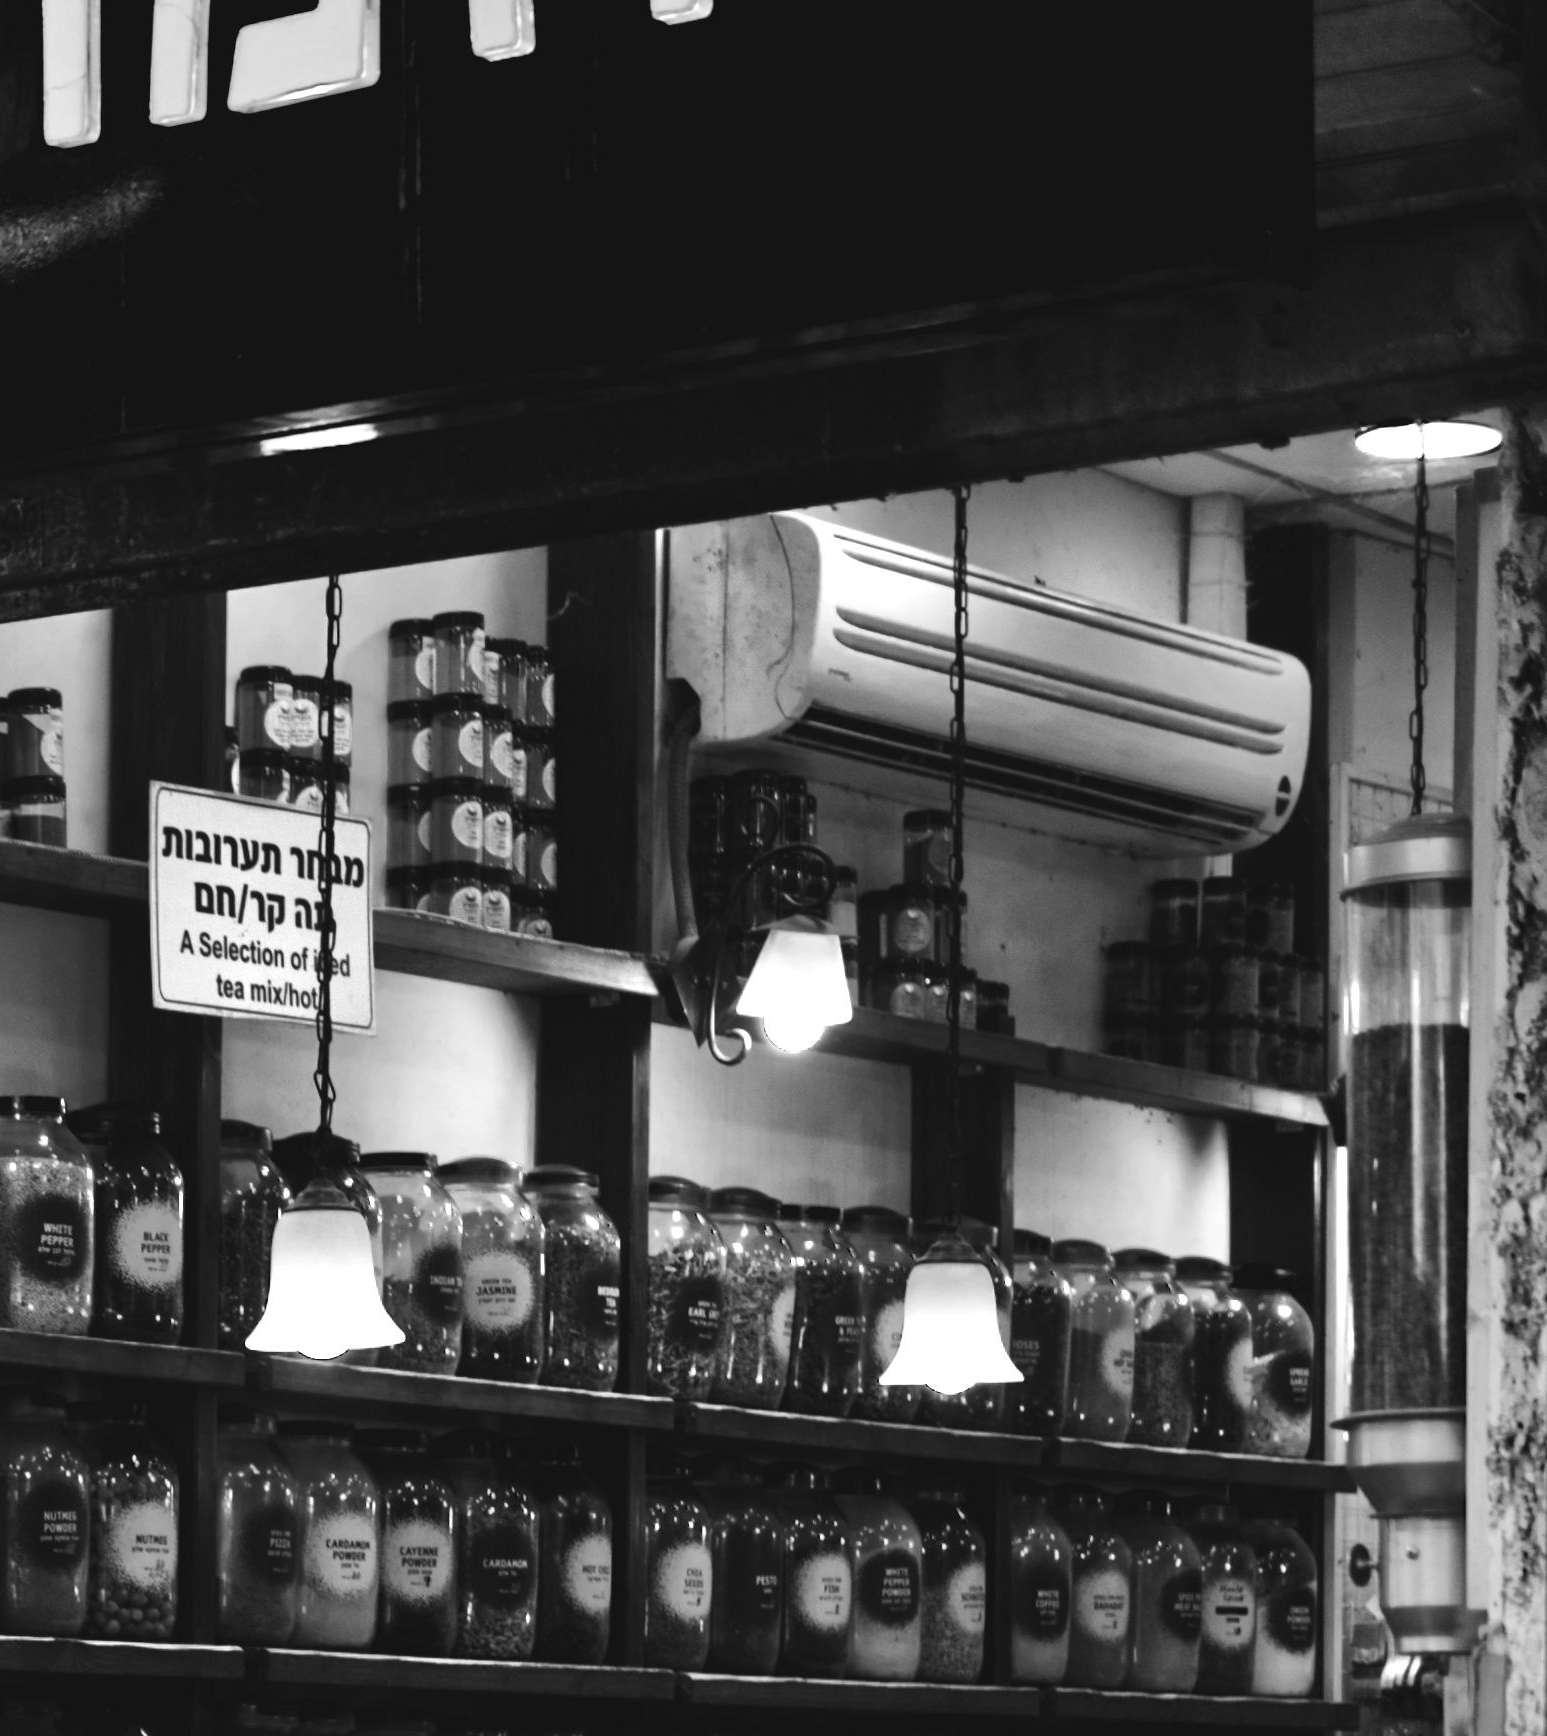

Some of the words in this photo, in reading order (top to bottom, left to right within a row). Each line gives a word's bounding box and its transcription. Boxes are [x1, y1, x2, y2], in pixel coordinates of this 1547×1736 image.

[161, 825, 282, 876] תערובות
[179, 929, 195, 955] A
[198, 931, 285, 969] Selection
[290, 946, 309, 972] of
[215, 973, 245, 1000] tea
[250, 979, 320, 1011] mix/hot
[43, 1222, 73, 1236] WHITE
[40, 1234, 74, 1248] PEPPER
[142, 1230, 169, 1242] BLACK
[140, 1243, 171, 1255] PEPPER
[475, 1285, 517, 1297] JASMINE
[332, 1550, 366, 1562] POWDER
[399, 1545, 439, 1557] CAYENNE
[401, 1557, 437, 1568] POWDER
